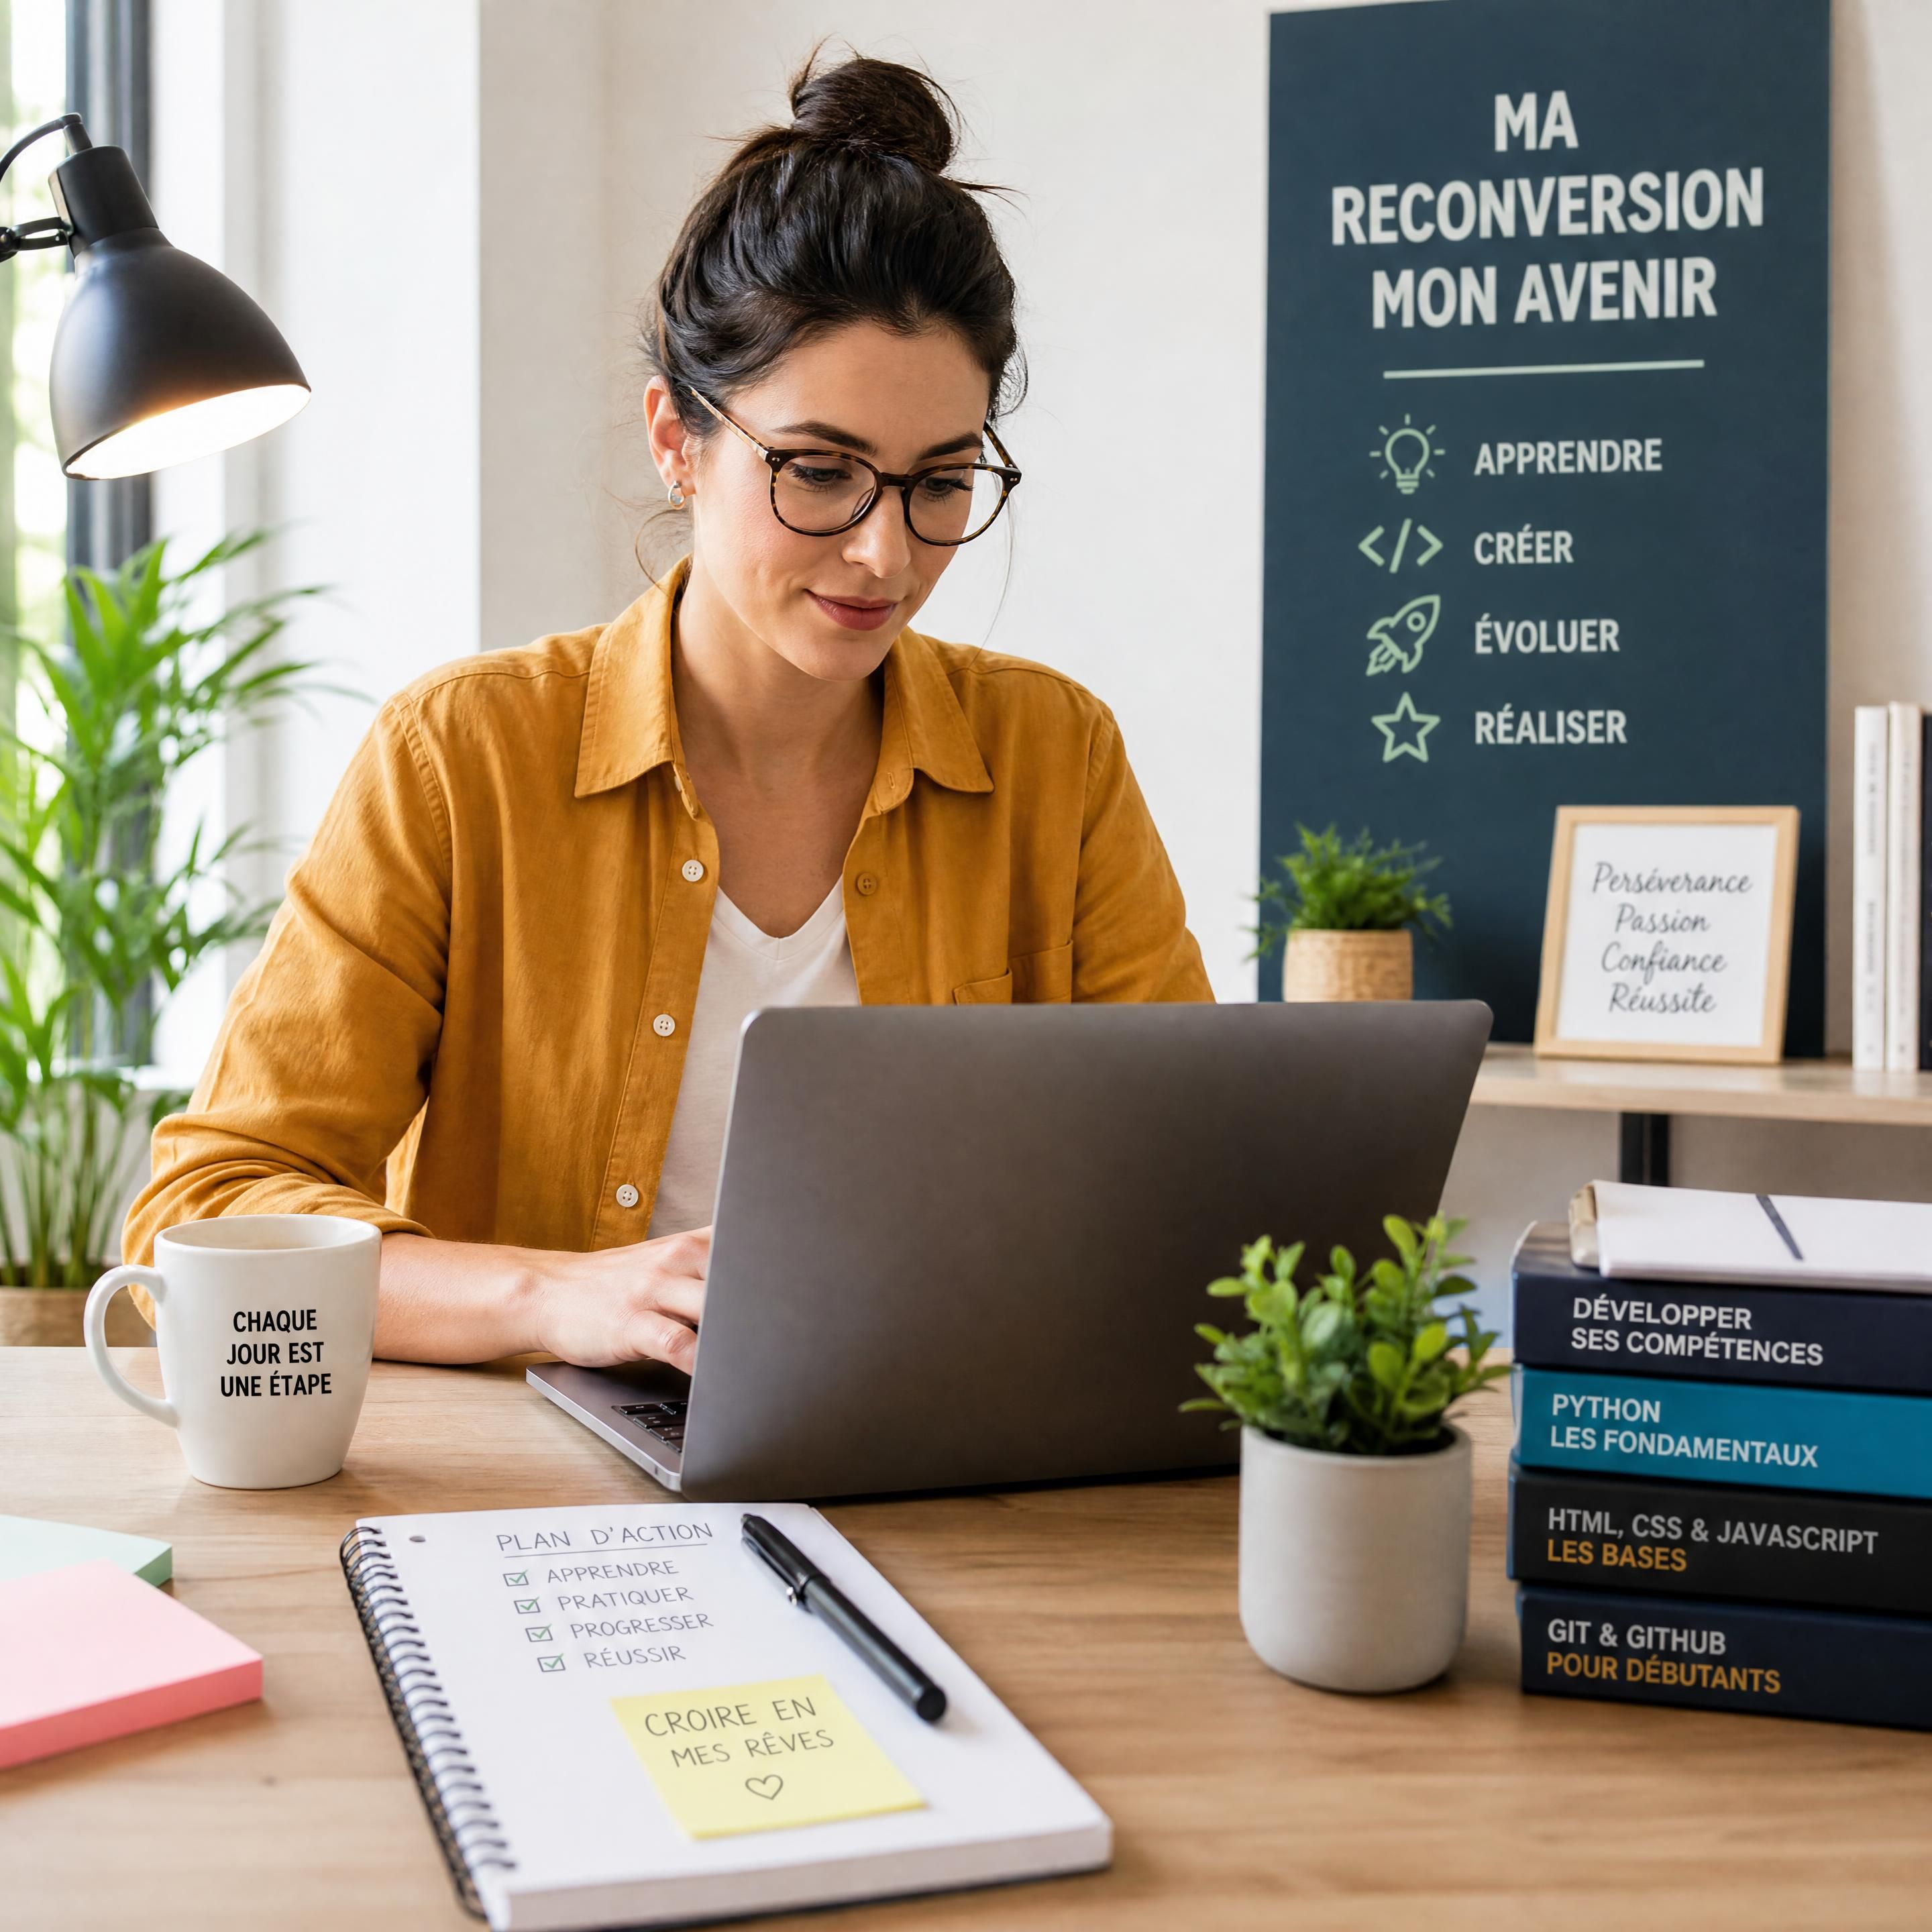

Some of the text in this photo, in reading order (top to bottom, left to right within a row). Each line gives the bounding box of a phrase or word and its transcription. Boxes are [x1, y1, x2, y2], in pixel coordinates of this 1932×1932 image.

[1495, 90, 1579, 152] MA
[1332, 166, 1764, 246] RECONVERSION
[1373, 256, 1717, 329] MON AVENIR
[1474, 438, 1662, 476] APPRENDRE
[1474, 524, 1574, 565] CRÉER
[1475, 613, 1620, 654] ÉVOLUER
[1475, 704, 1628, 745] RÉALISER
[1593, 861, 1753, 894] Perséverance
[1615, 903, 1711, 934] Passion
[1601, 941, 1727, 984] Confiance
[1609, 982, 1717, 1014] Réussite
[233, 1309, 317, 1333] CHAQUE
[1572, 1294, 1752, 1330] DÉVELOPPER
[227, 1342, 324, 1364] JOUR EST
[1570, 1328, 1824, 1366] SES COMPÉTENCES
[221, 1371, 331, 1397] UNE ÉTAPE
[1552, 1393, 1661, 1423] PYTHON
[1550, 1426, 1819, 1468] LES FONDAMENTAUX
[496, 1523, 713, 1551] PLAN D'ACTION
[1548, 1508, 1879, 1555] HTML, CSS & JAVASCRIPT
[547, 1560, 680, 1583] APPRENDRE
[1547, 1539, 1687, 1572] LES BASES
[557, 1587, 694, 1611] PRATIQUER
[570, 1613, 714, 1639] PROGRESSER
[1548, 1618, 1727, 1655] GIT & GITHUB
[584, 1646, 686, 1668] RÉUSSIR
[1547, 1652, 1781, 1694] POUR DÉBUTANTS
[645, 1697, 816, 1736] CROIRE EN
[670, 1729, 835, 1768] MES RÊVES
